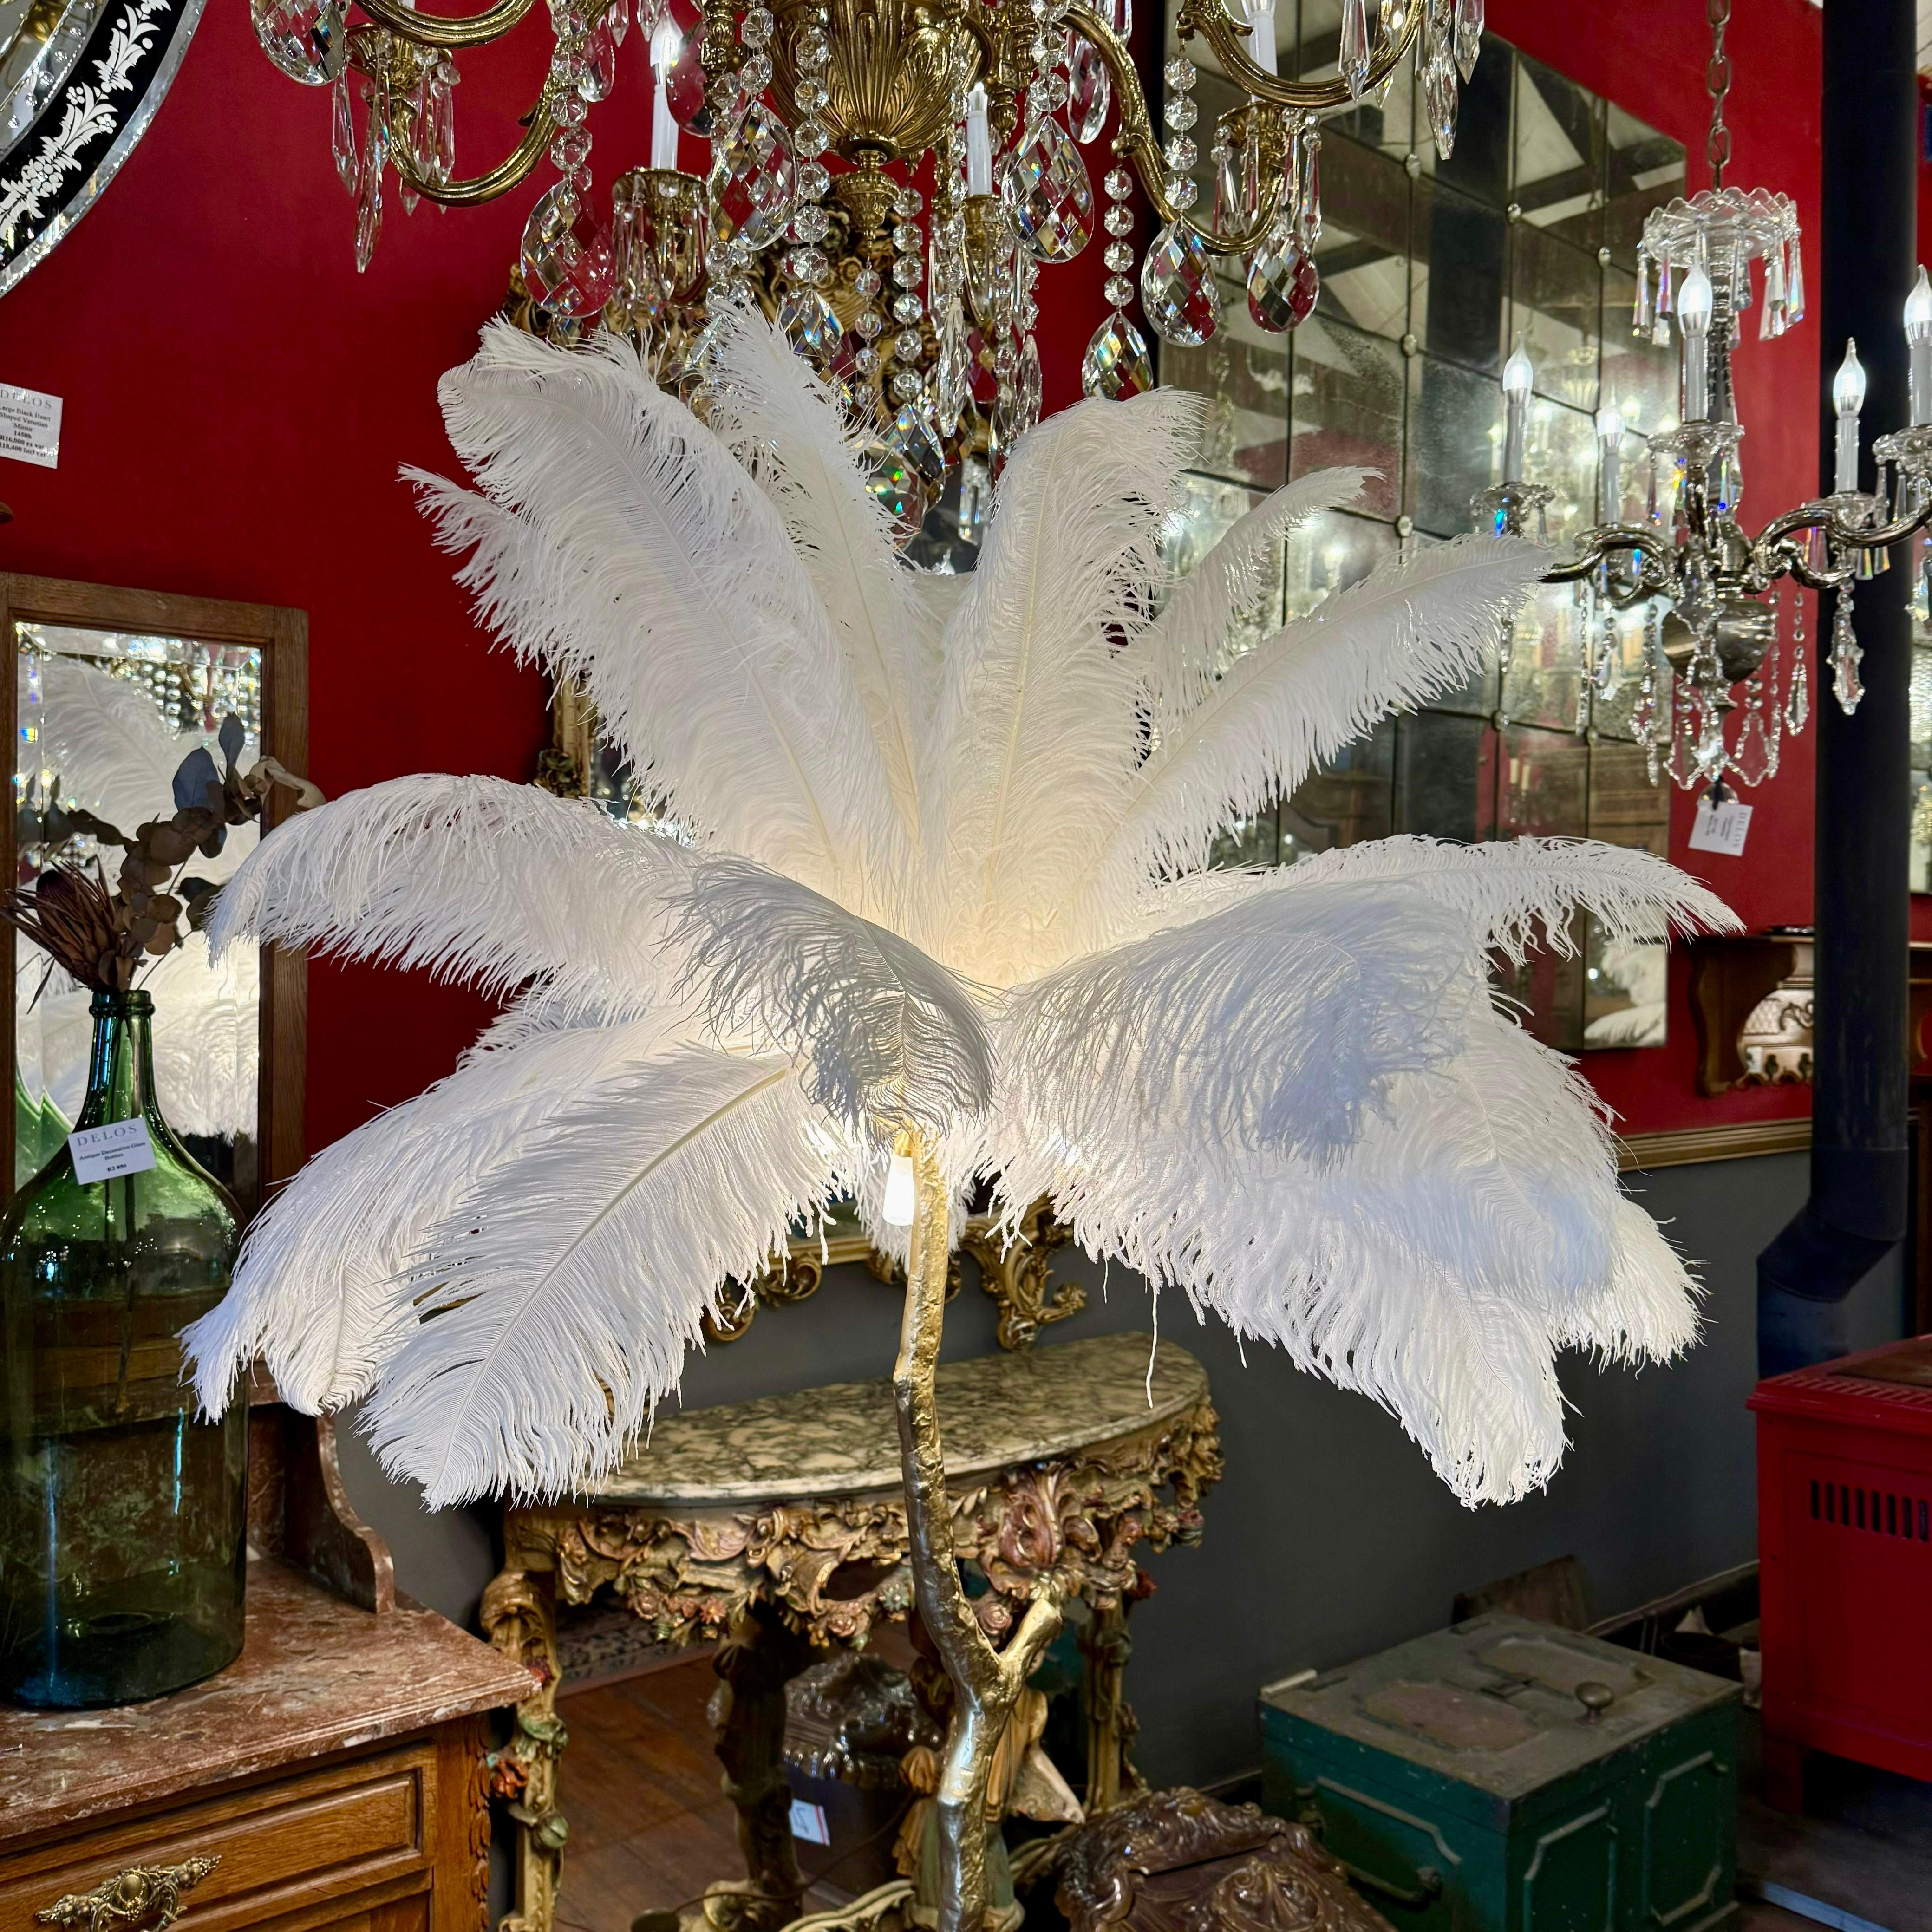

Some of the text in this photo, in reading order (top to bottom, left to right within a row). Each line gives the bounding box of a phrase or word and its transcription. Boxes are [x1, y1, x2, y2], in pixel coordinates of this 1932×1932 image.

[0, 412, 48, 427] Shaped Venetian
[17, 408, 33, 417] Black
[35, 412, 51, 422] Heart
[14, 422, 33, 432] Mirror
[77, 1124, 137, 1146] DELOS
[101, 1146, 130, 1155] Decorative
